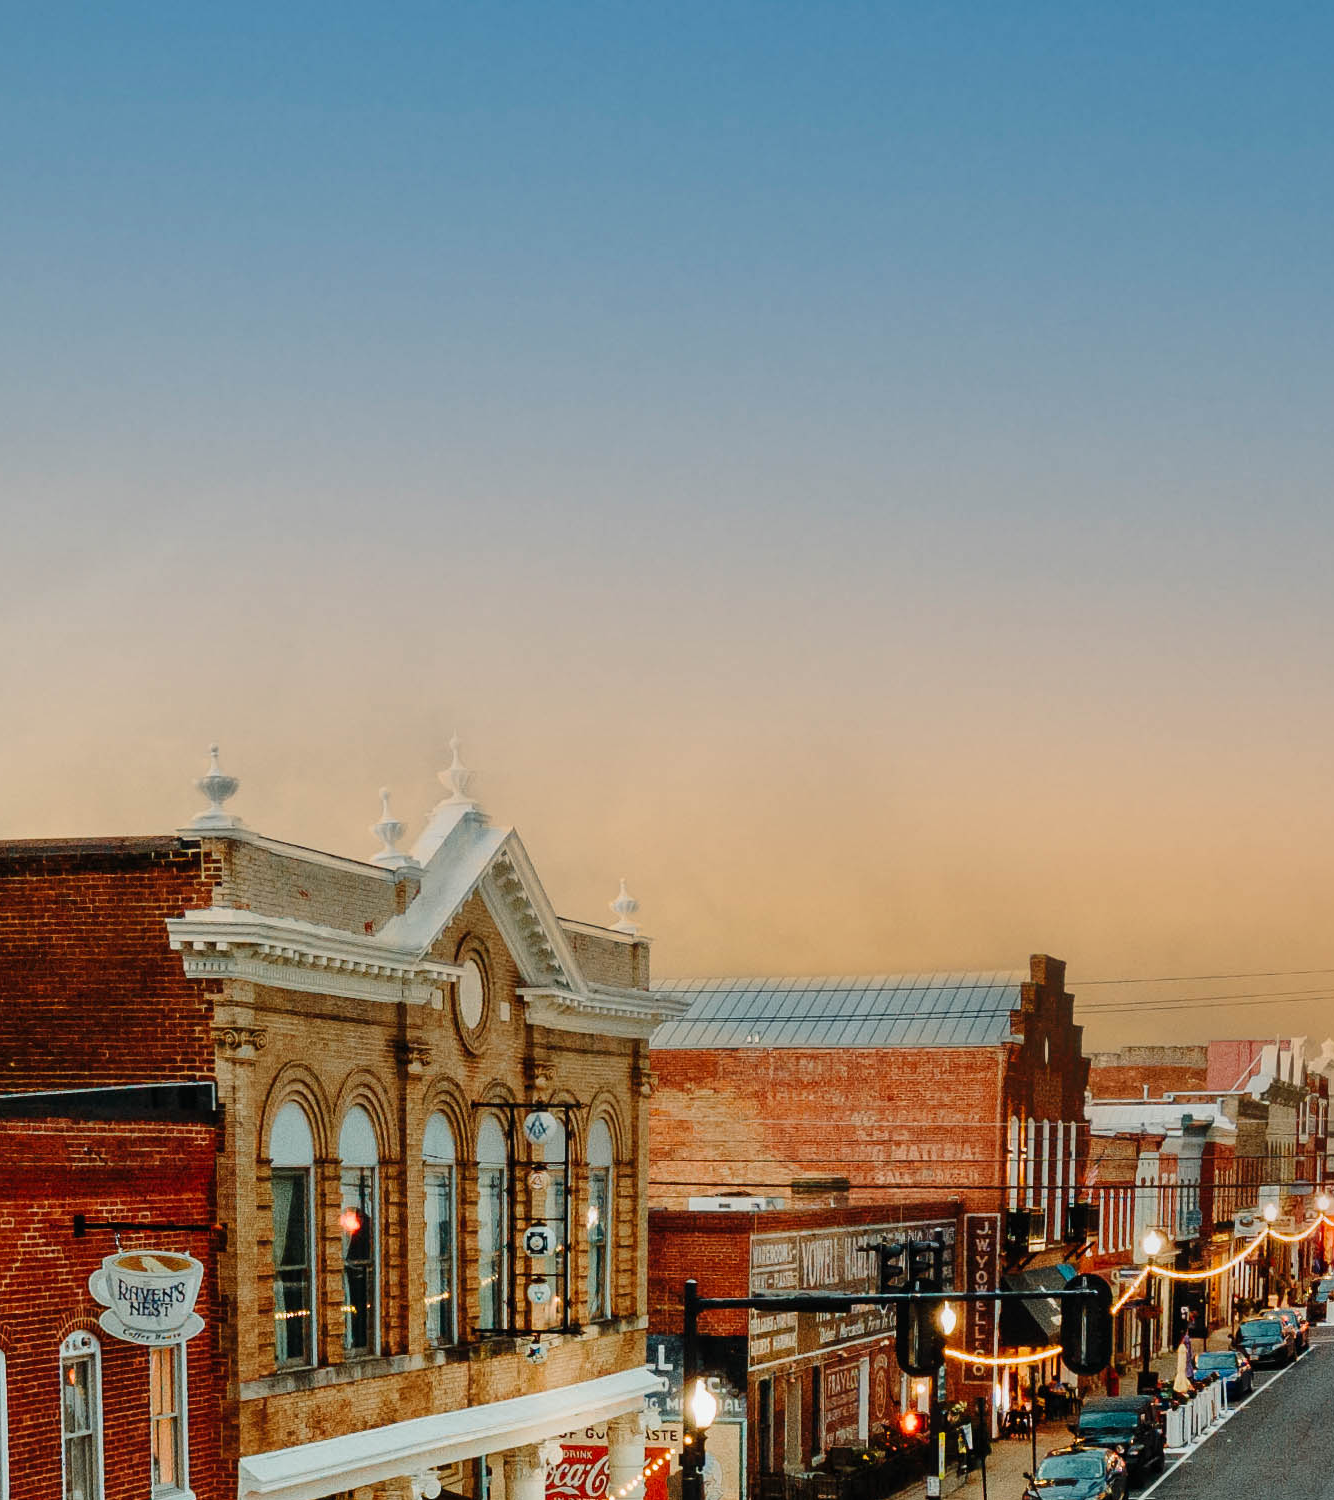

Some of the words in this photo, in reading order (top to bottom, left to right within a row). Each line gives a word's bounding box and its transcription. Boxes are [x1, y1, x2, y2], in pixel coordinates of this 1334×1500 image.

[117, 1278, 186, 1303] RAVEN'S
[129, 1301, 173, 1317] NEST
[123, 1328, 149, 1340] Coffee
